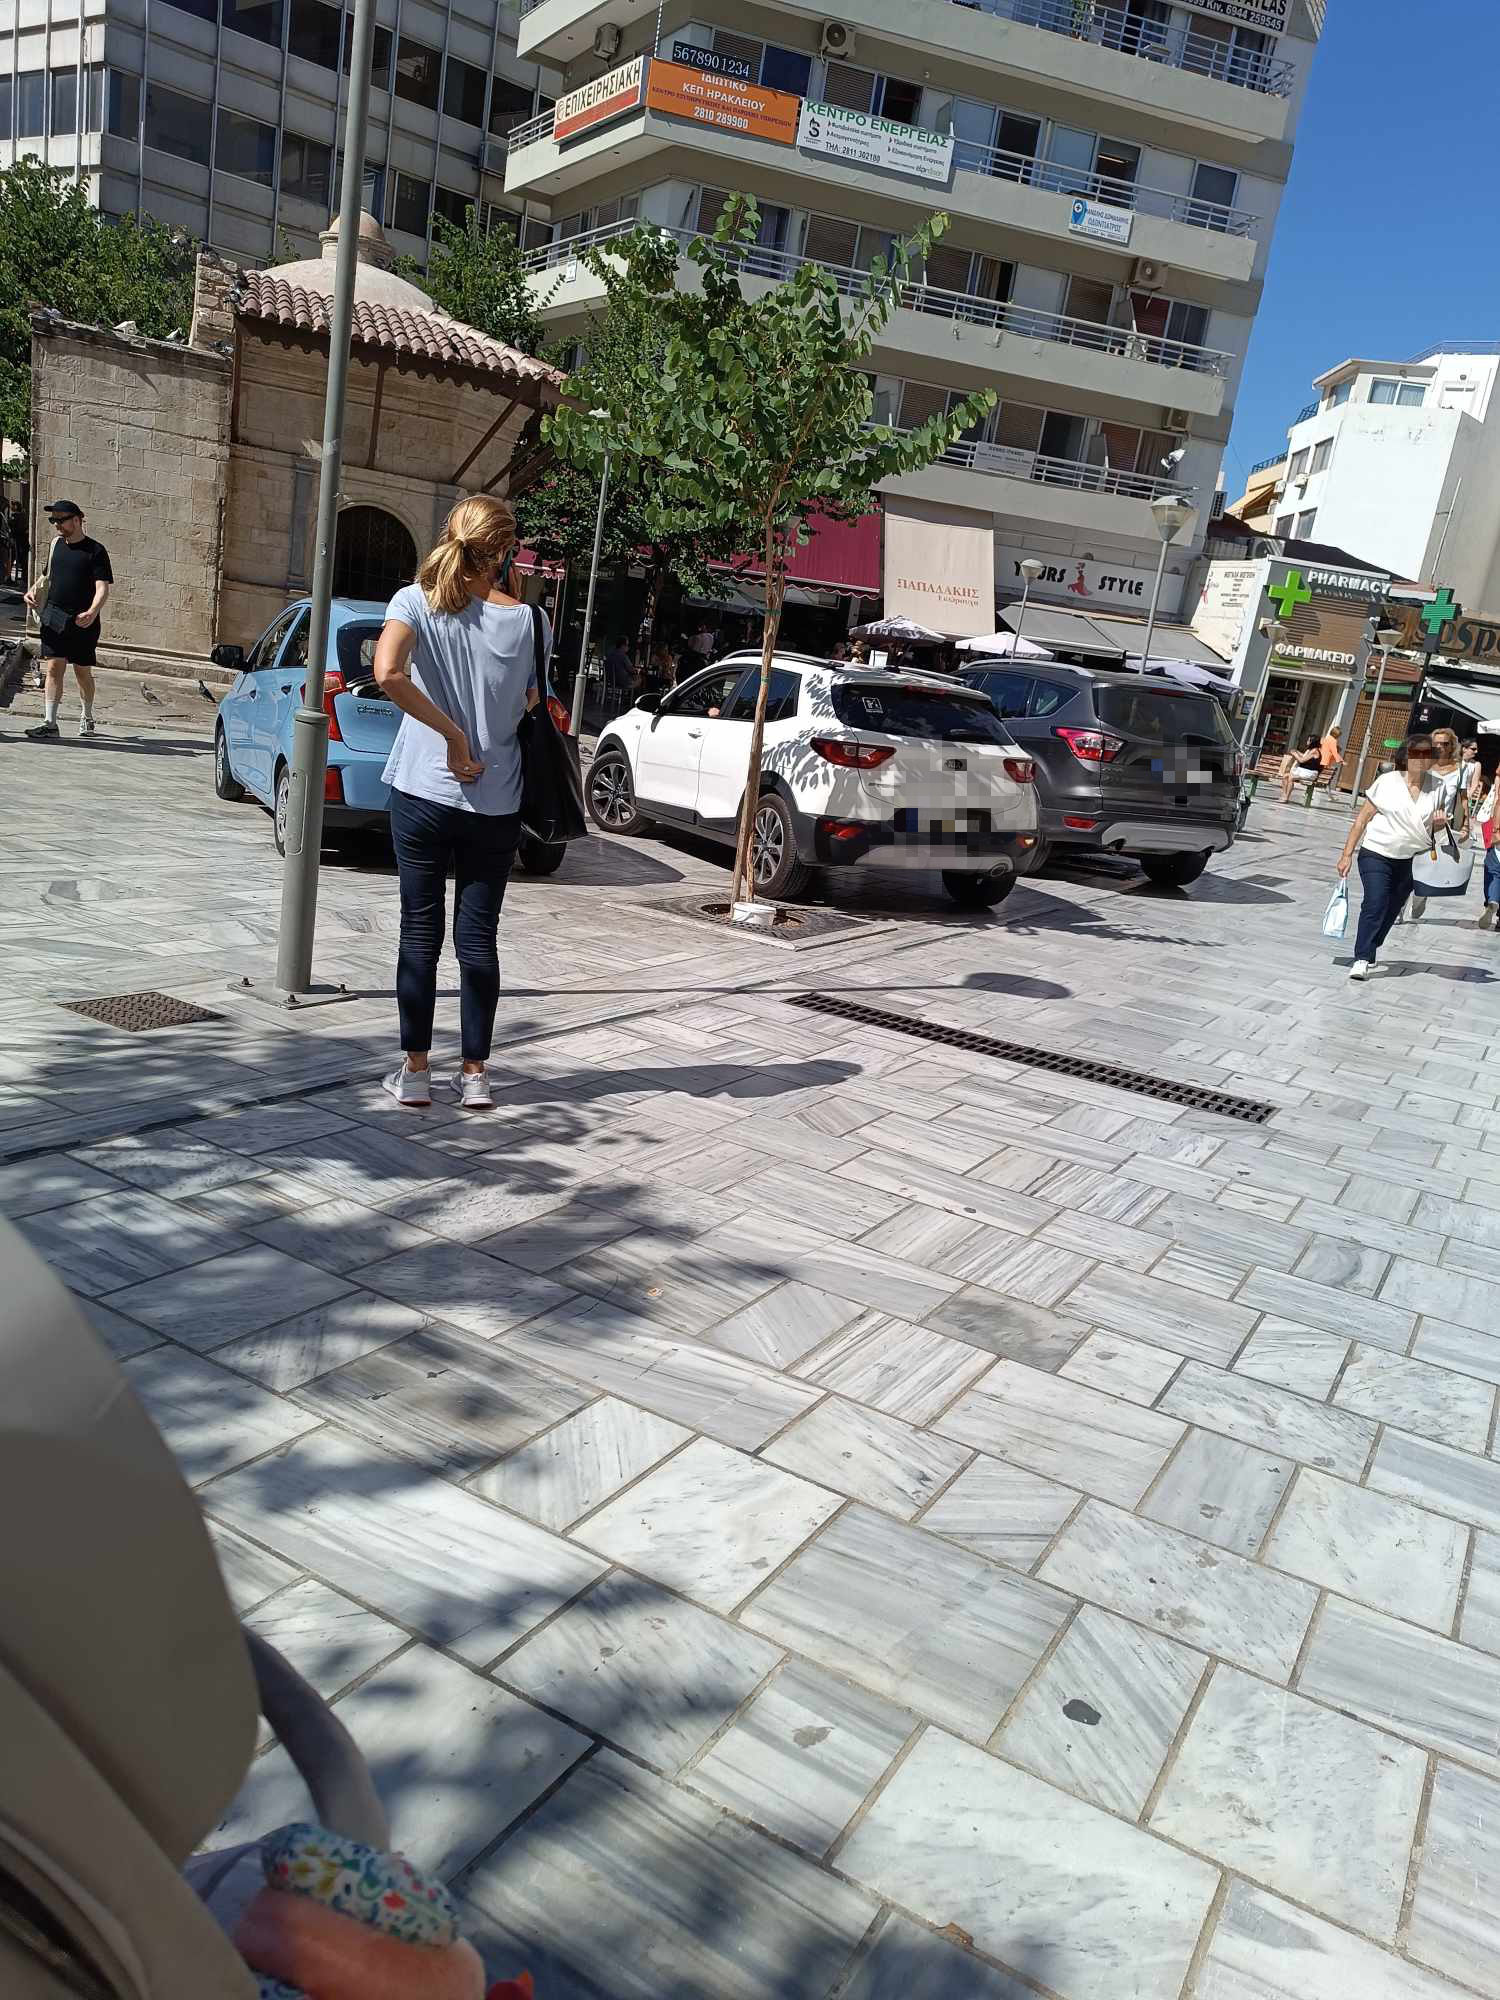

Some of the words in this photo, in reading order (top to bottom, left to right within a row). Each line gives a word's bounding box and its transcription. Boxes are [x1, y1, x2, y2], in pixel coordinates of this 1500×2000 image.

[1225, 5, 1248, 20] 6944
[1249, 12, 1283, 30] 259545
[565, 61, 641, 117] ΕΠΙΧΕΙΡΗΣΙΑΚΗ
[700, 72, 748, 92] ΙΔΙΩΤΙΚΟ
[682, 82, 704, 96] ΚΕΠ
[706, 89, 766, 112] ΗΡΑΚΛΕΙΟΥ
[694, 106, 715, 121] 2810
[716, 111, 749, 129] 289900
[805, 101, 867, 127] ΚΕΝΤΡΟ
[870, 118, 949, 149] ΕΝΕΡΓΕΙΑΣ
[1013, 560, 1067, 583] YURS
[1307, 570, 1391, 594] PHARMACY
[897, 578, 980, 599] ΠΑΠΑΔΑΚΗΣ
[1097, 575, 1144, 597] STYLE
[1274, 643, 1356, 665] ΦΑΡΜΑΚΕΙΟ
